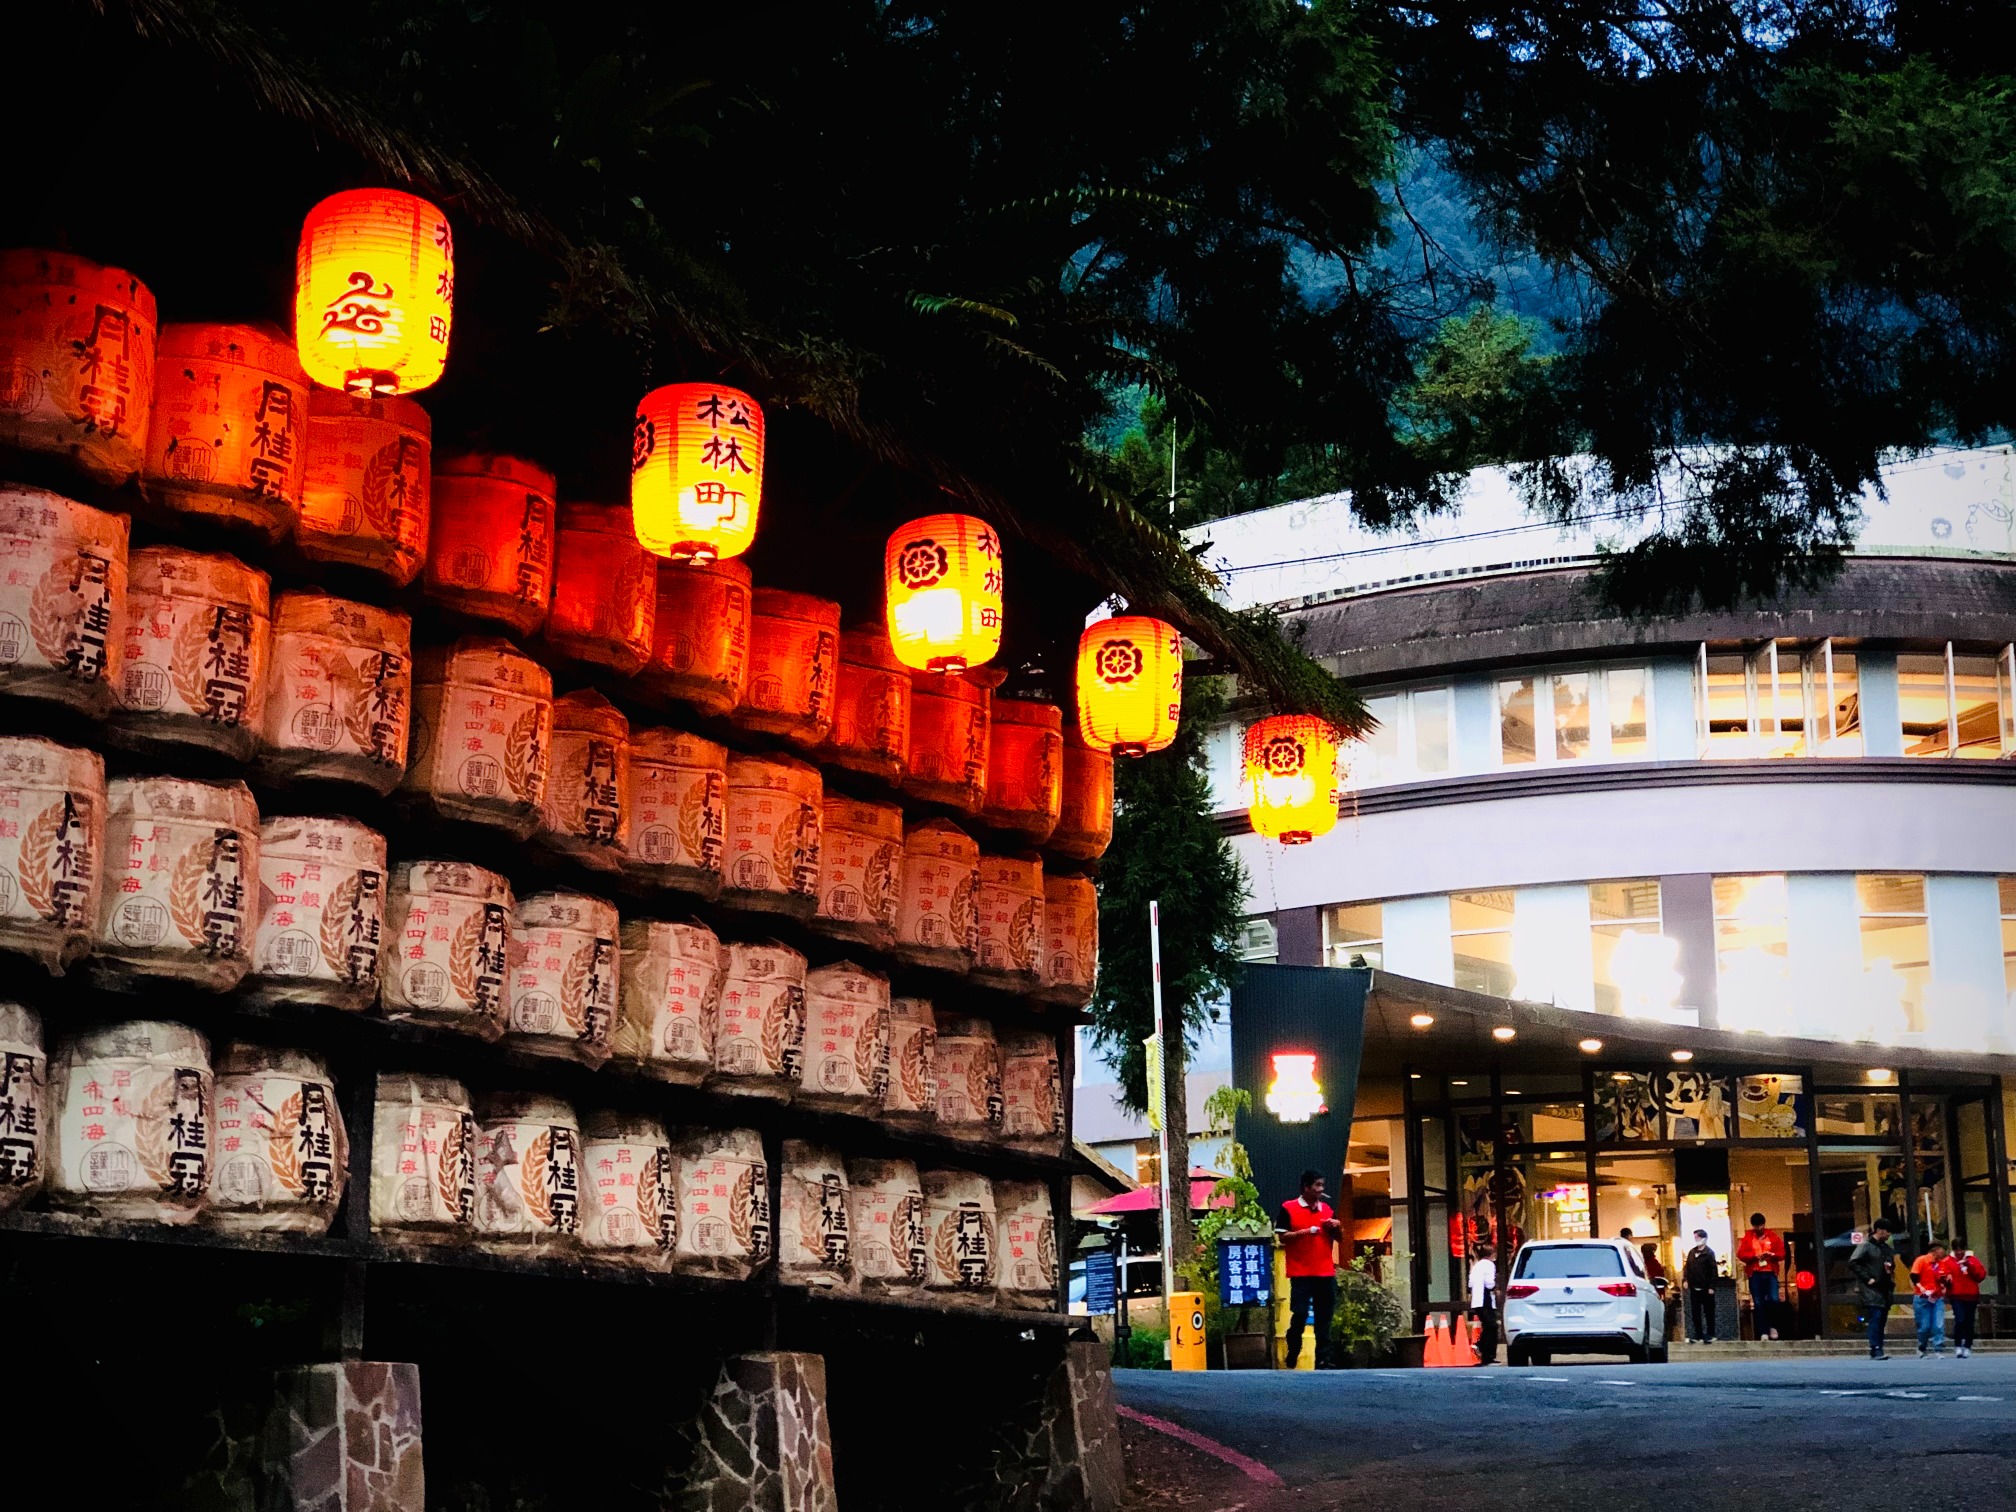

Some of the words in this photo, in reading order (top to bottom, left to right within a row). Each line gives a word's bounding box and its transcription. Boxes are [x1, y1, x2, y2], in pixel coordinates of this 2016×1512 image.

[79, 303, 130, 438] 月桂冠
[251, 380, 292, 503] 月桂冠
[389, 434, 424, 556] 月桂冠
[696, 394, 753, 522] 松林町
[514, 493, 548, 607] 月桂冠
[62, 550, 110, 684] 月桂冠
[201, 605, 252, 727] 月桂冠
[574, 740, 619, 847] 月桂冠
[697, 772, 723, 876] 月桂冠
[50, 791, 95, 930] 月桂冠
[202, 828, 245, 959] 月桂冠
[342, 869, 382, 985] 月桂冠
[474, 903, 506, 1017] 月桂冠
[576, 937, 614, 1047] 月桂冠
[0, 1052, 38, 1187] 月桂冠
[163, 1068, 207, 1198] 月桂冠
[298, 1082, 334, 1204] 月桂冠
[546, 1126, 578, 1234] 月桂冠
[655, 1146, 677, 1251] 月桂冠
[749, 1164, 770, 1260] 月桂冠
[818, 1174, 850, 1269] 月桂冠
[953, 1202, 989, 1290] 月桂冠
[1244, 1244, 1260, 1289] 停車場
